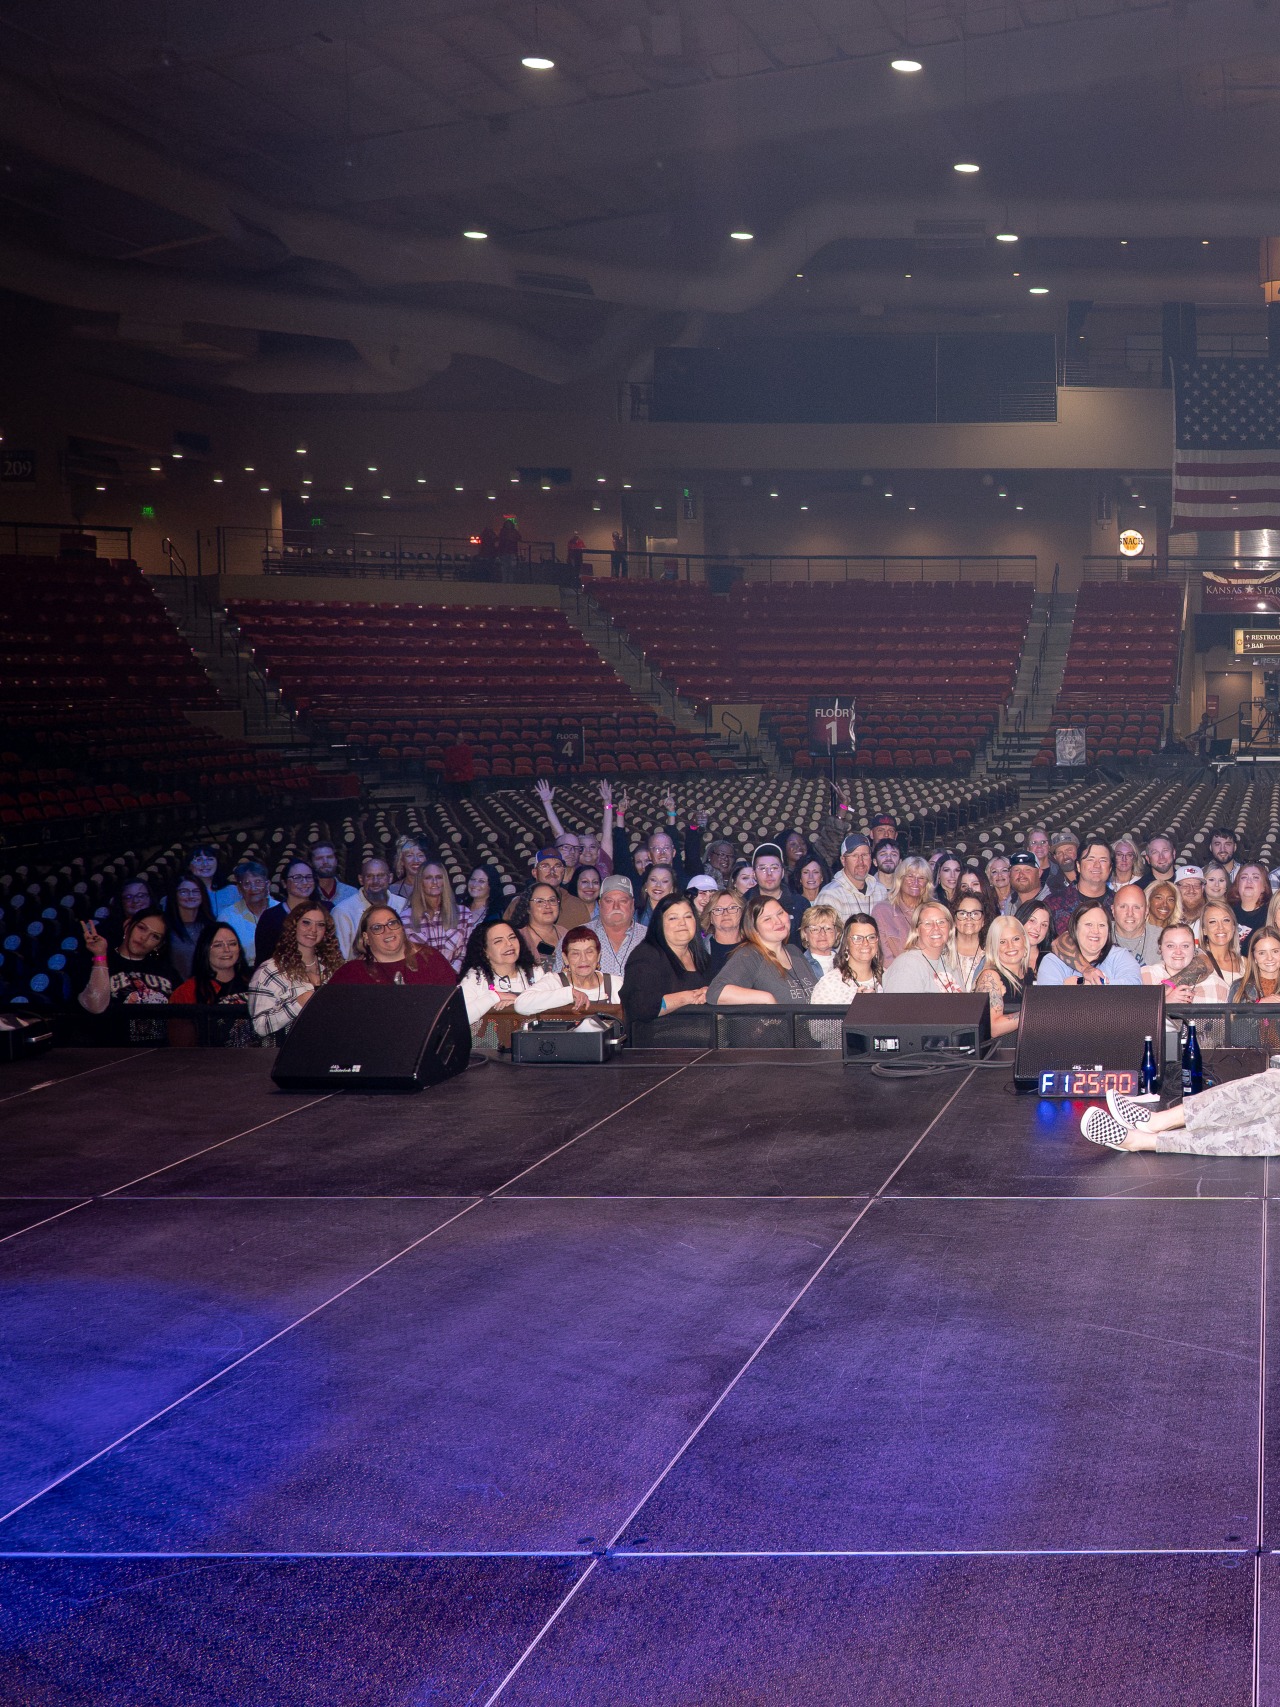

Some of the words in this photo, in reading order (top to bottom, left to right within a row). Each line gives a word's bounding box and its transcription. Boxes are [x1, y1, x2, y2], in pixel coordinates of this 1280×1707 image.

[3, 460, 32, 477] 209
[1119, 537, 1144, 546] SNACK
[1206, 585, 1243, 595] KANSAS
[815, 708, 849, 718] FLOOR
[825, 721, 838, 746] 1
[561, 741, 574, 757] 4
[144, 973, 173, 995] UP
